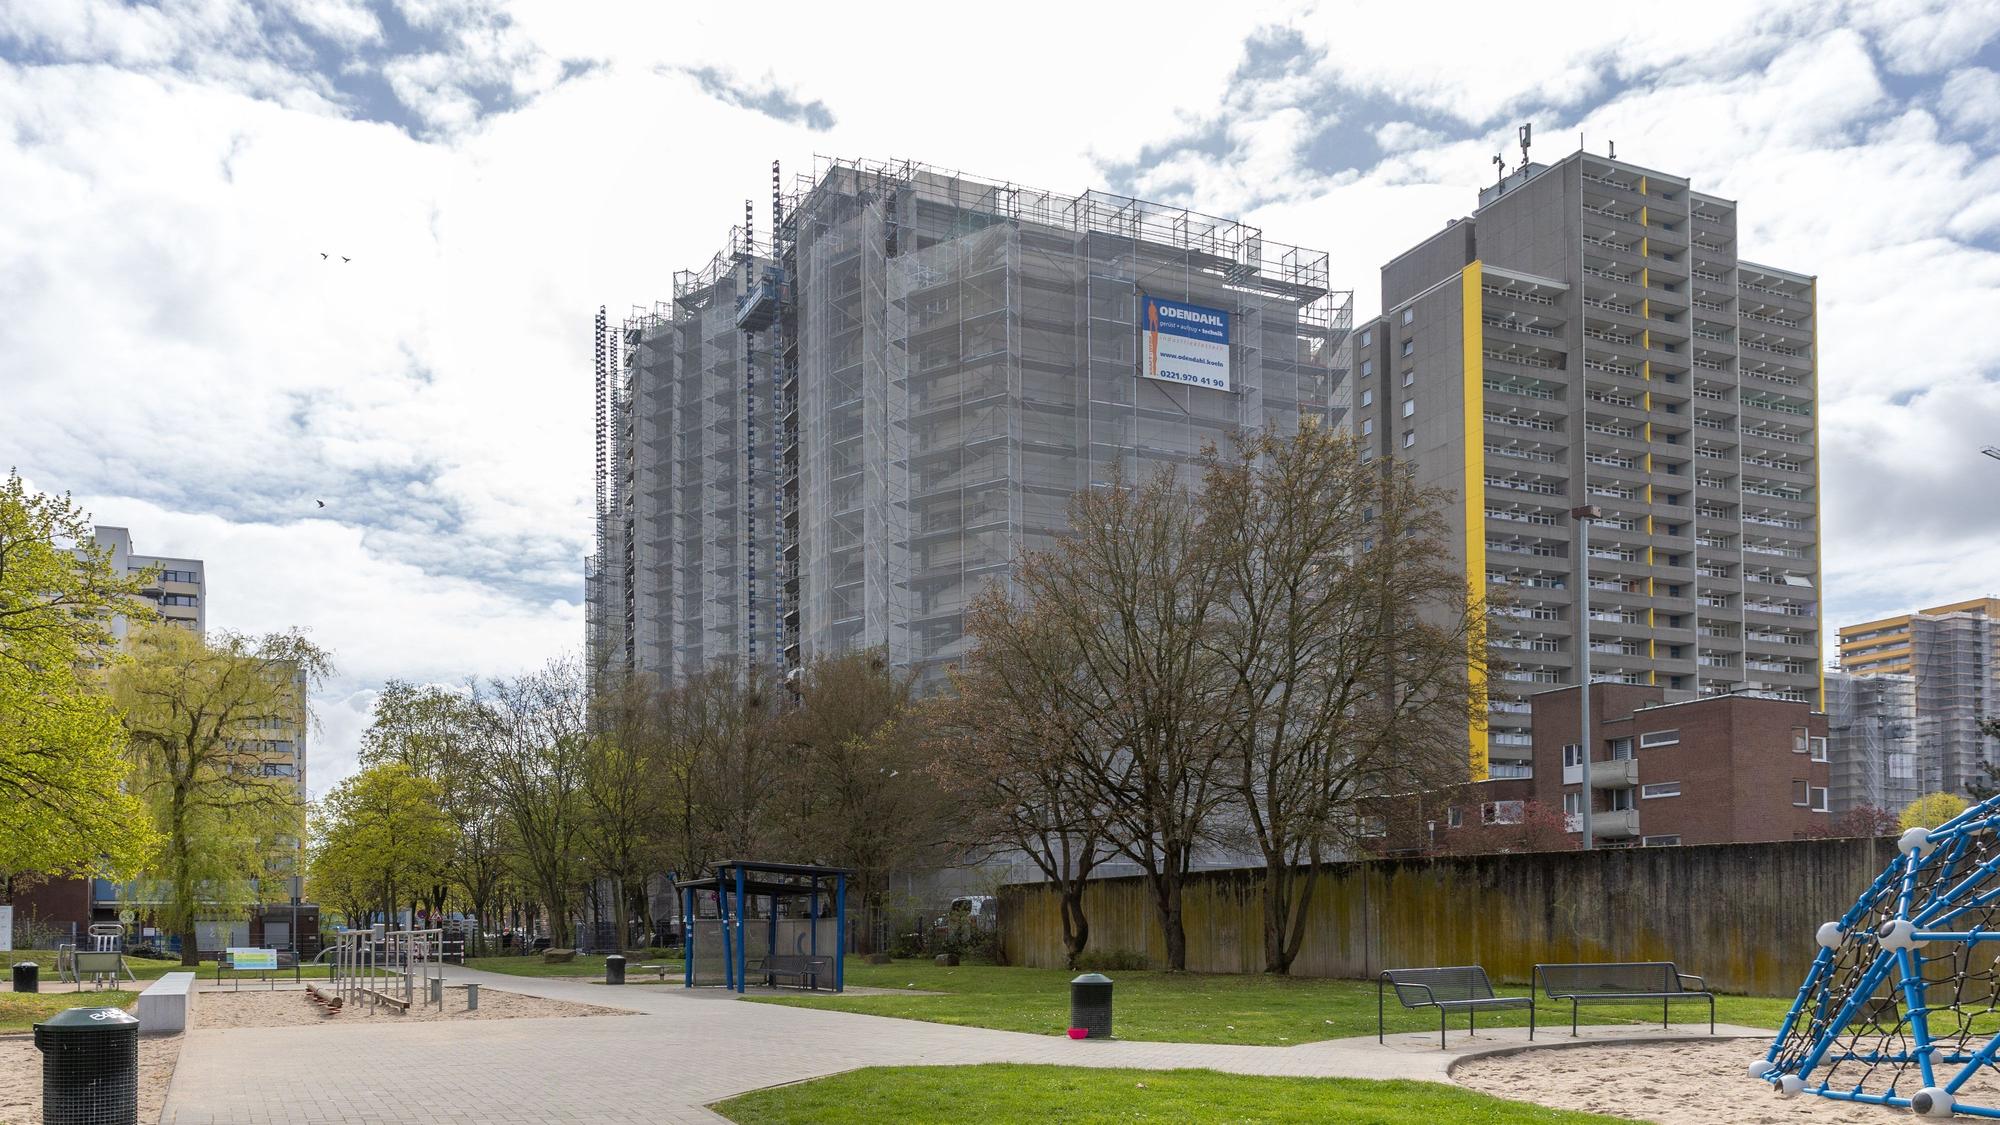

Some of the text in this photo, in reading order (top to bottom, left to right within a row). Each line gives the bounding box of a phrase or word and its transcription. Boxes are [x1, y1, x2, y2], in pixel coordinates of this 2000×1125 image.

[1160, 306, 1223, 327] ODENDAHL
[1160, 351, 1224, 368] www.odendahl.koeln
[1160, 370, 1224, 387] 0221.970 41 90
